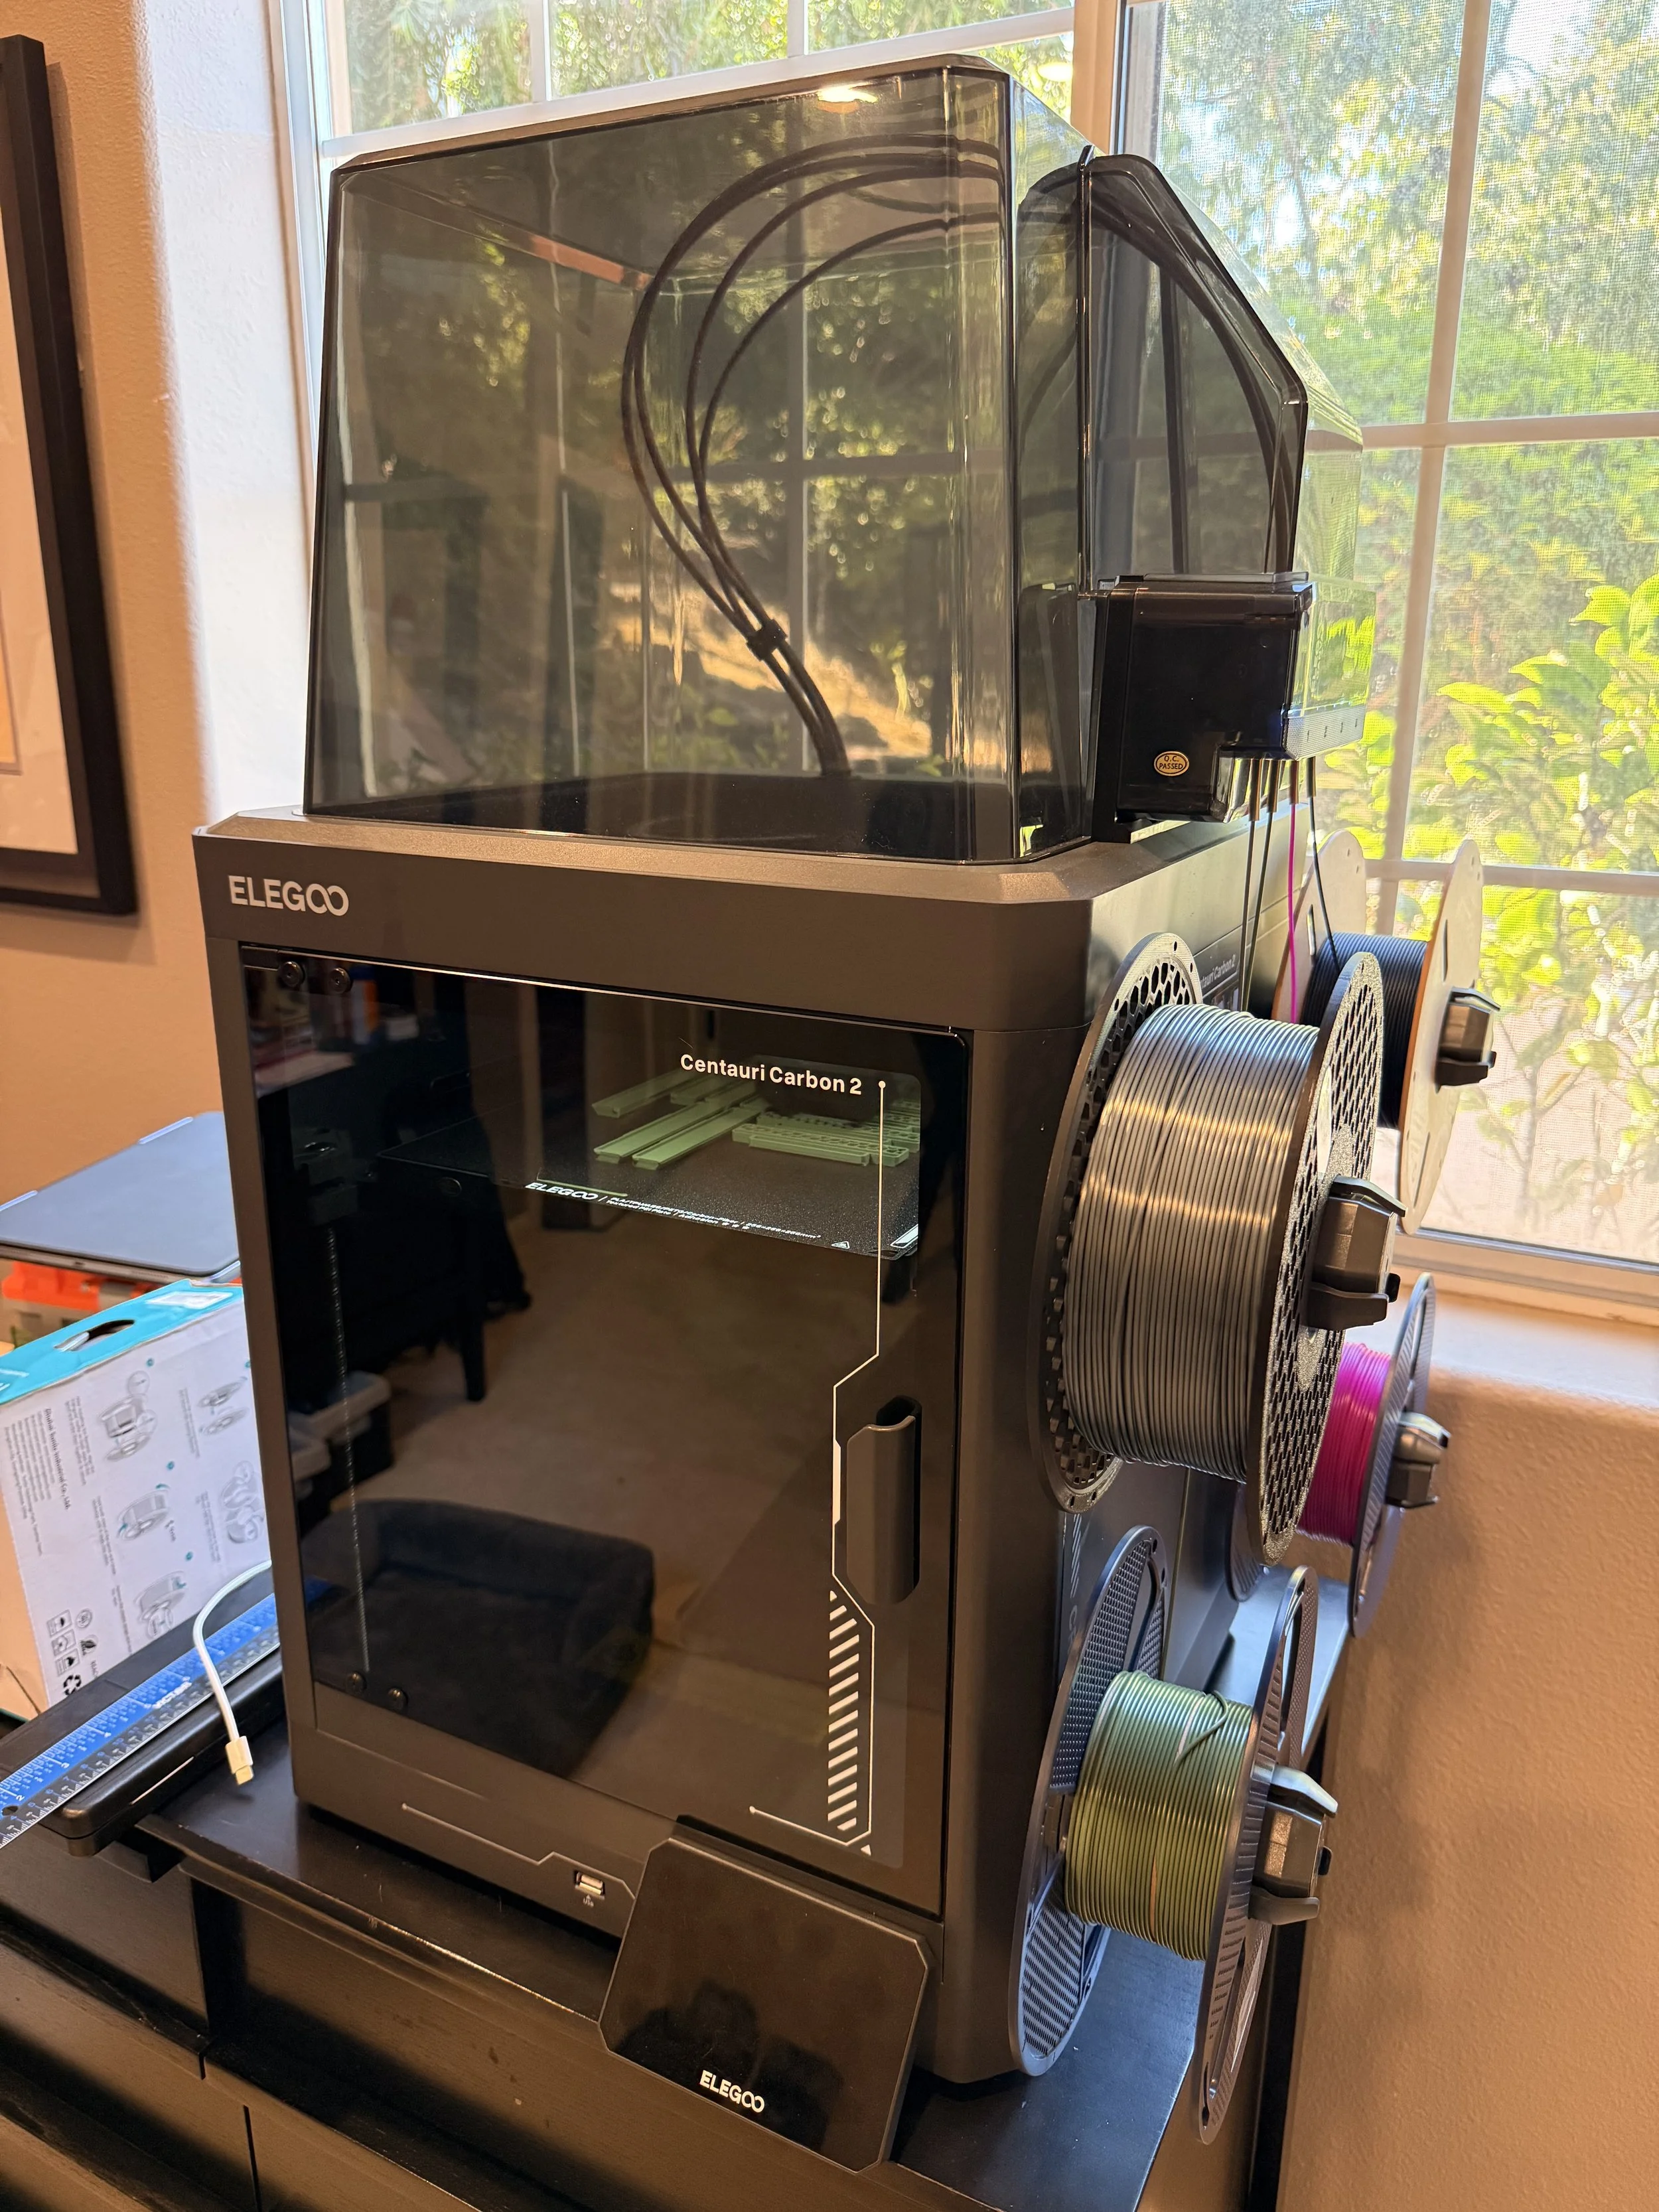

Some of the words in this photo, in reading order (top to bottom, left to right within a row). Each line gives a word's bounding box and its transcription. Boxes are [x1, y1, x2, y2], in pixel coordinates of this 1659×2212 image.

[228, 875, 349, 917] ELEGOO
[680, 1054, 765, 1081] Centauri
[769, 1066, 845, 1092] Carbon
[849, 1077, 862, 1095] 2
[525, 1182, 599, 1200] ELEGOO
[699, 2069, 765, 2113] ELEGOO
